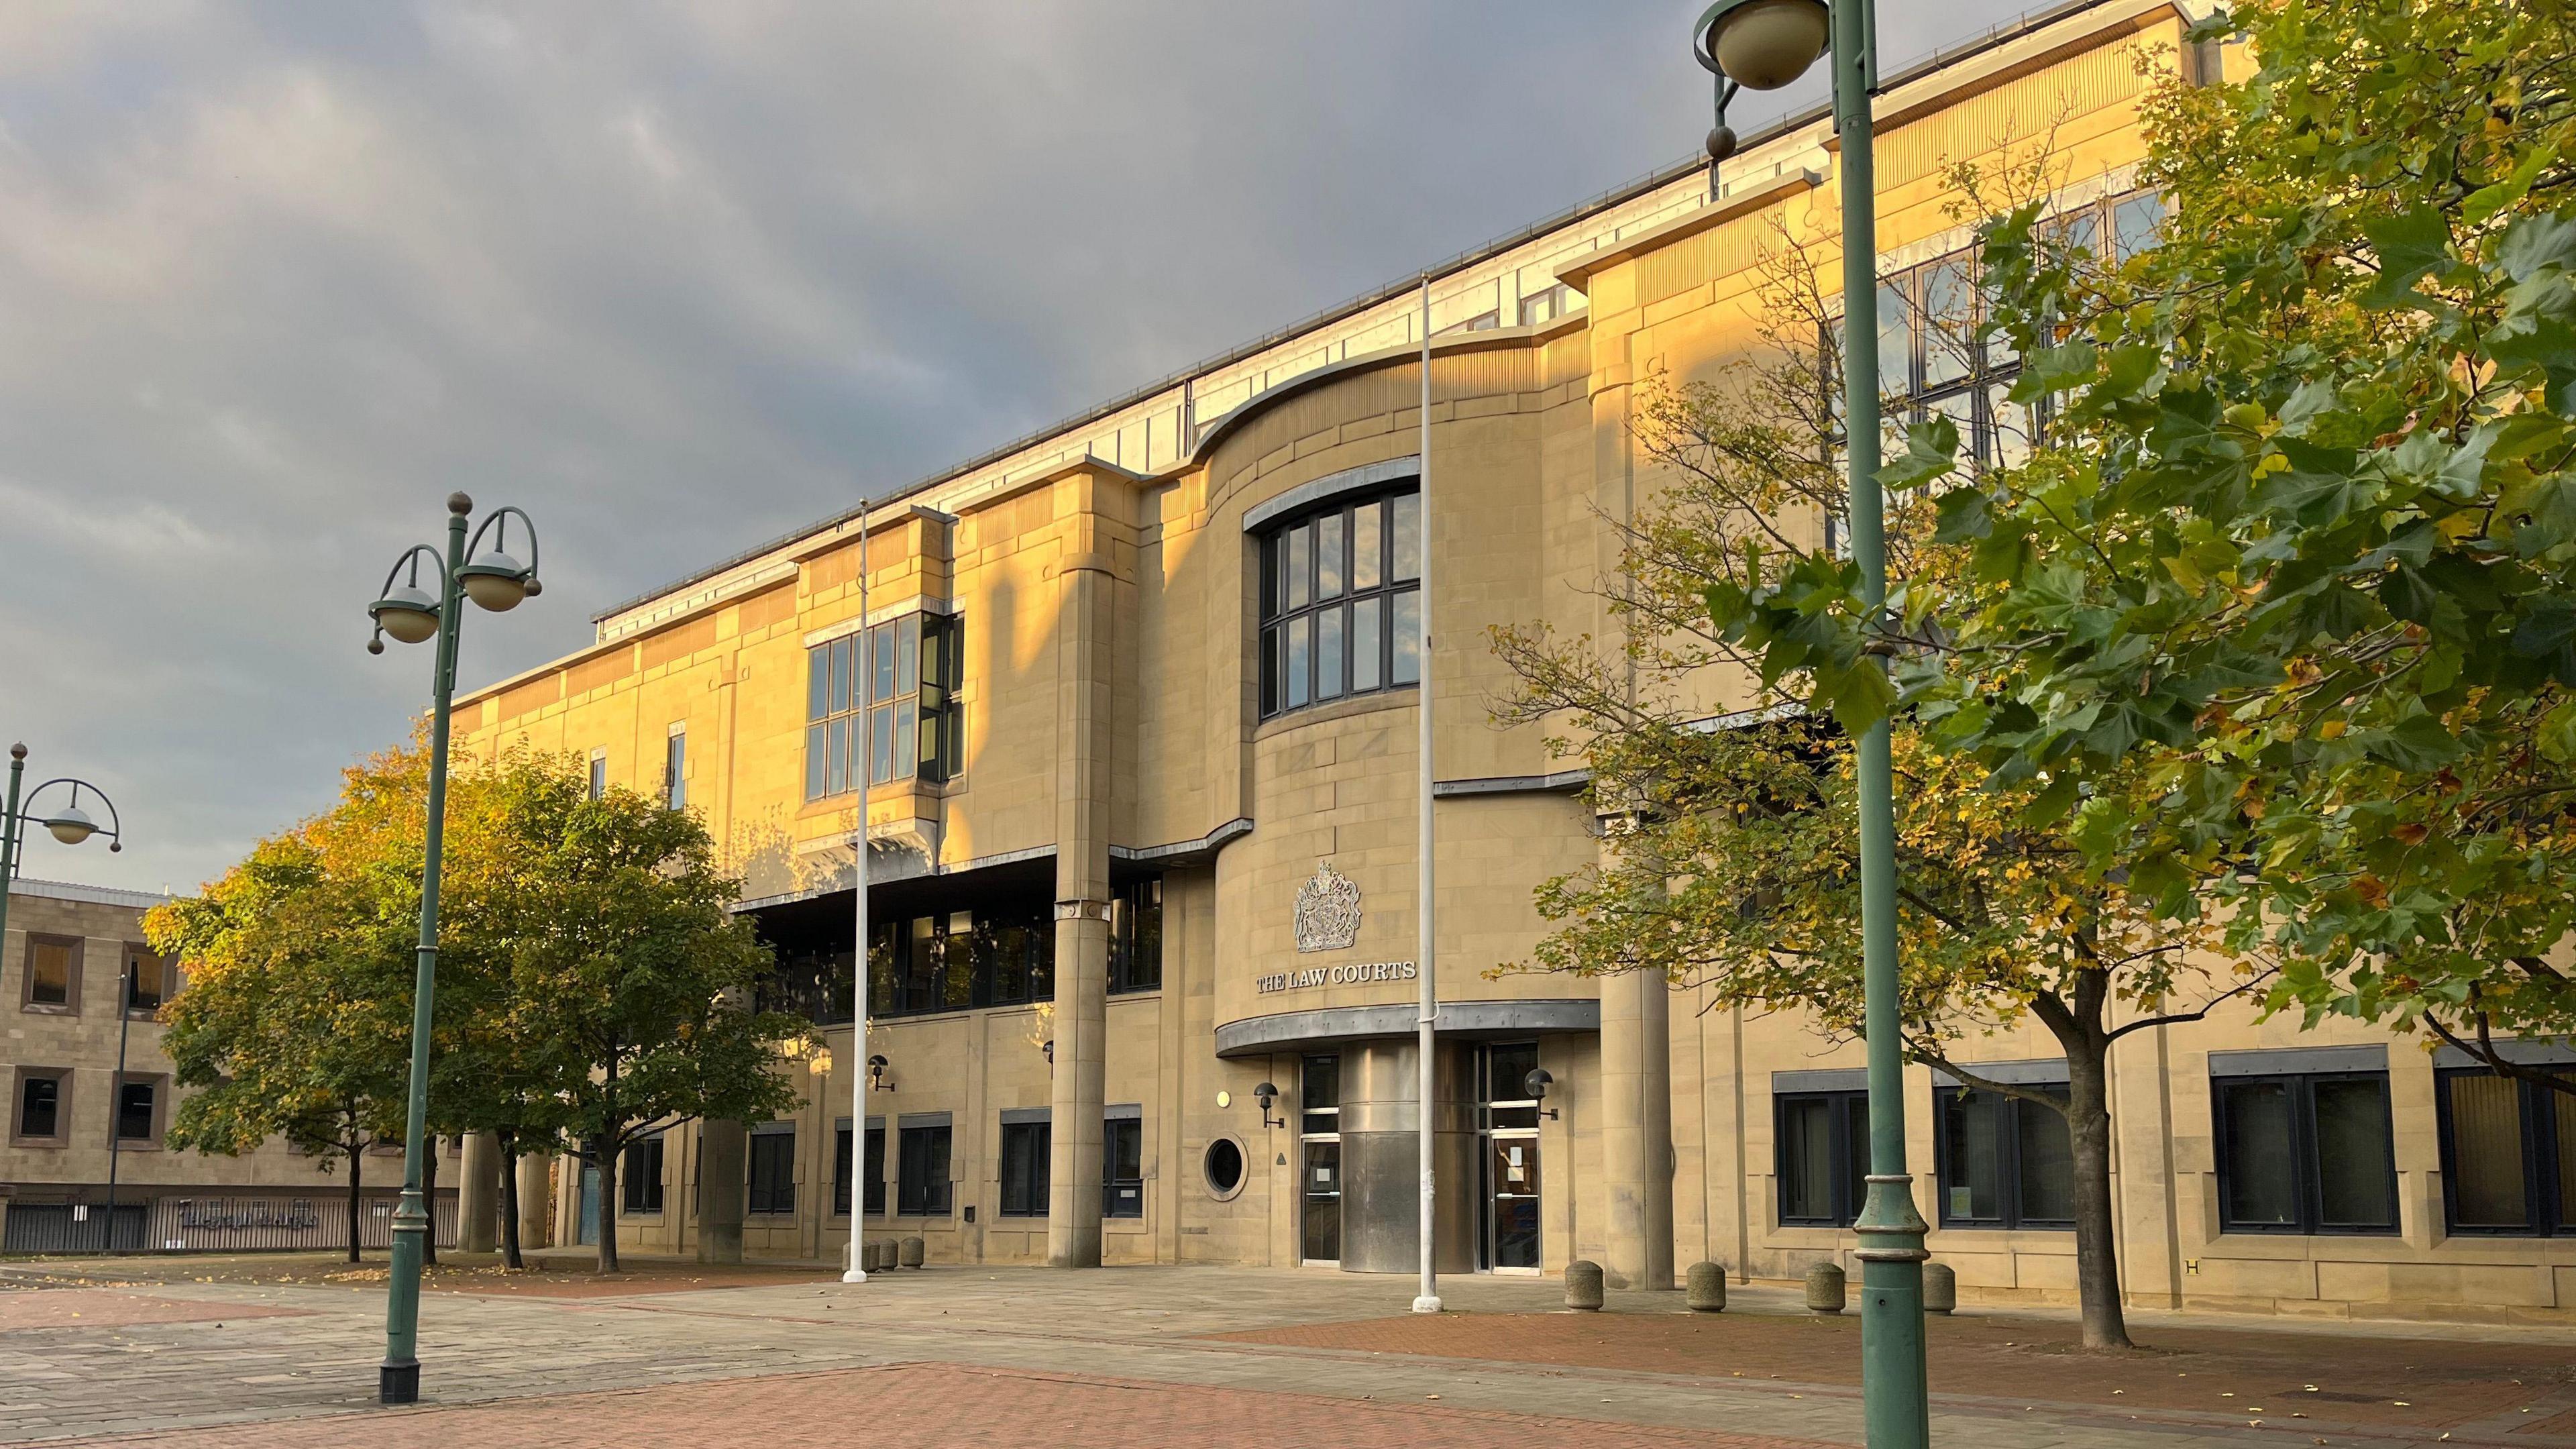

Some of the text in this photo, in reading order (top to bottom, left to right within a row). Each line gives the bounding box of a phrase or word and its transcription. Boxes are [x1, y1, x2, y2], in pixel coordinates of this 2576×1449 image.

[1257, 961, 1417, 994] THE LAW COURTS
[2185, 1260, 2200, 1274] H
